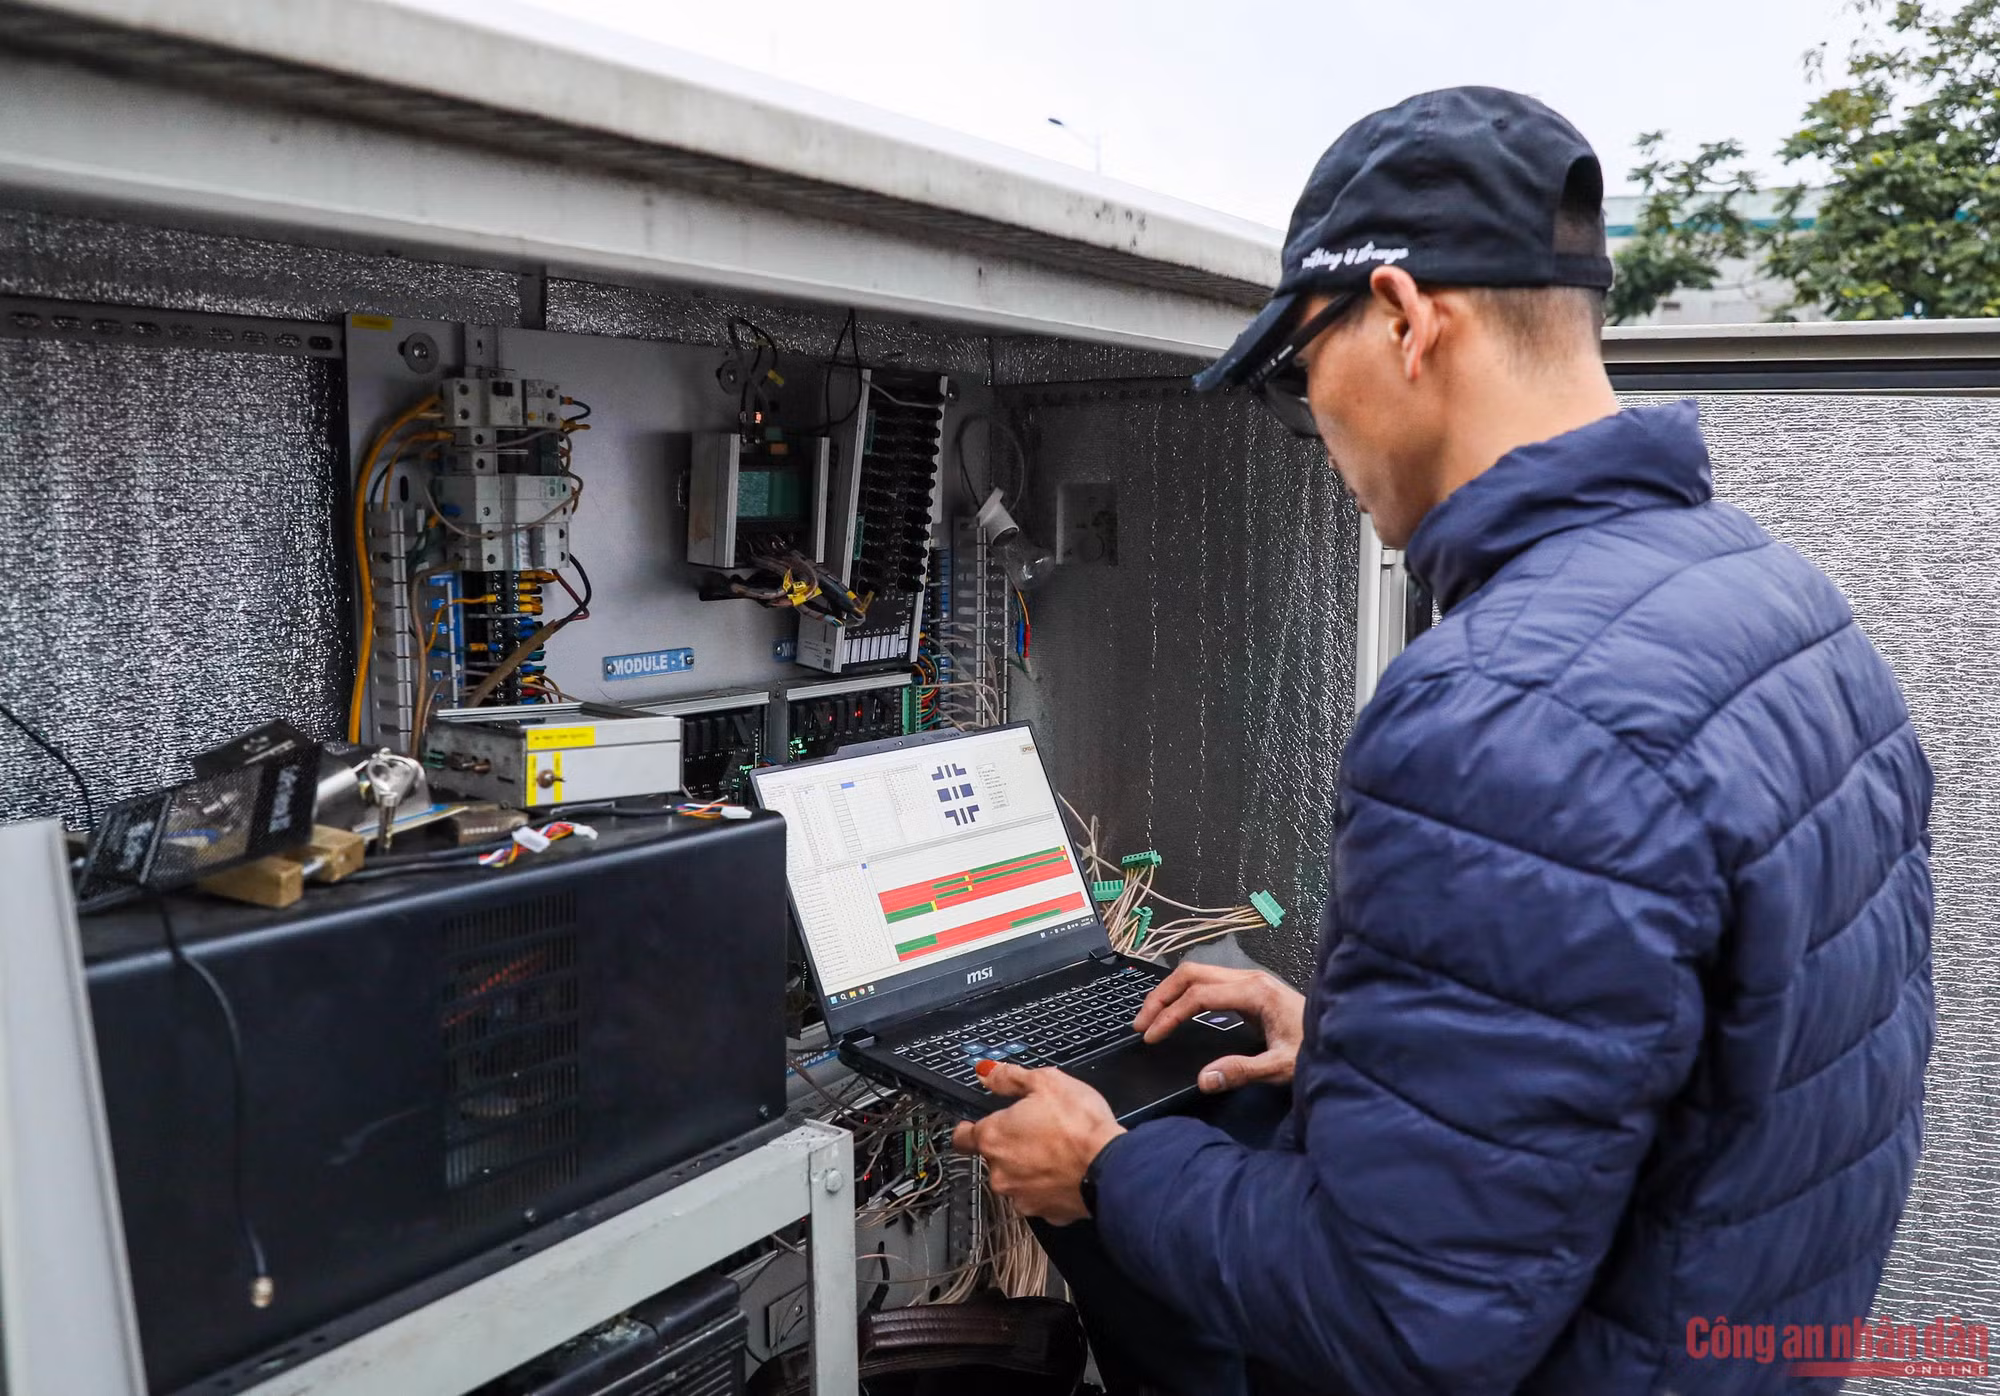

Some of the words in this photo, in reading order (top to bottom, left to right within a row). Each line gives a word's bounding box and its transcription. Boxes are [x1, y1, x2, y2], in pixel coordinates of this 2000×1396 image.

[612, 654, 669, 676] MODULE
[679, 652, 686, 668] 1
[966, 966, 993, 985] msi
